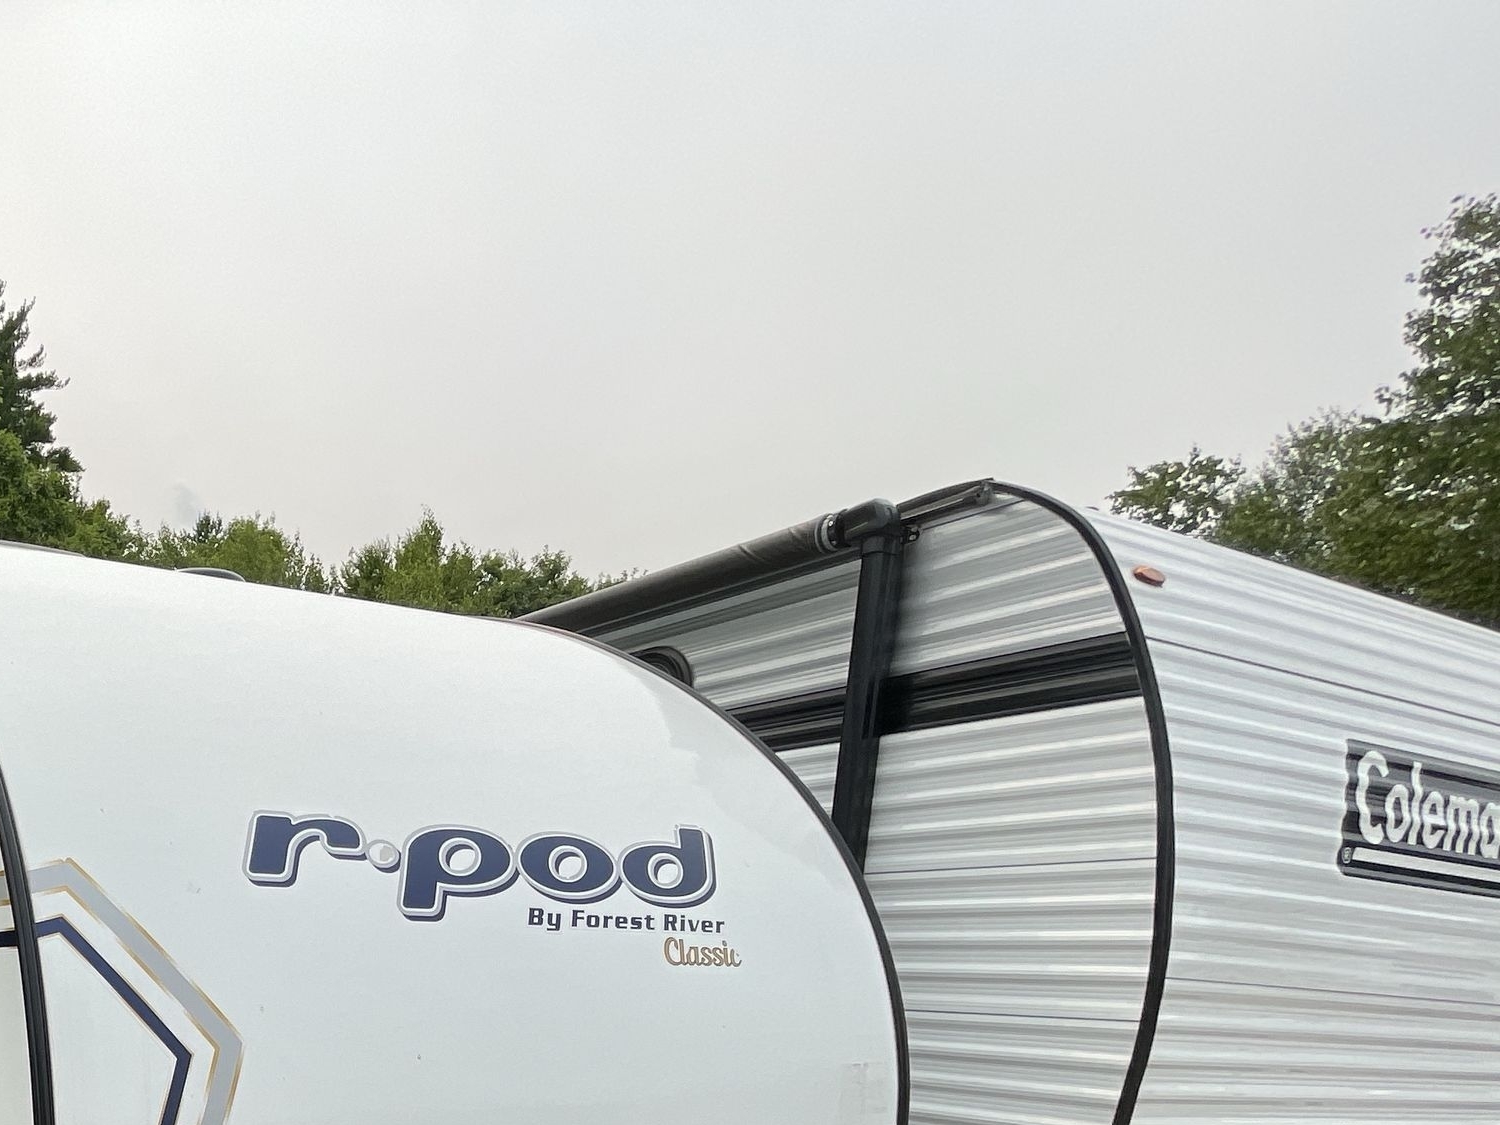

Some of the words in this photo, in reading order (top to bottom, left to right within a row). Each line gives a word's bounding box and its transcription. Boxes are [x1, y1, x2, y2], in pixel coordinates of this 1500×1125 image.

[527, 907, 562, 931] By
[571, 909, 655, 931] Forest
[663, 913, 725, 934] River
[663, 936, 742, 968] Classic
